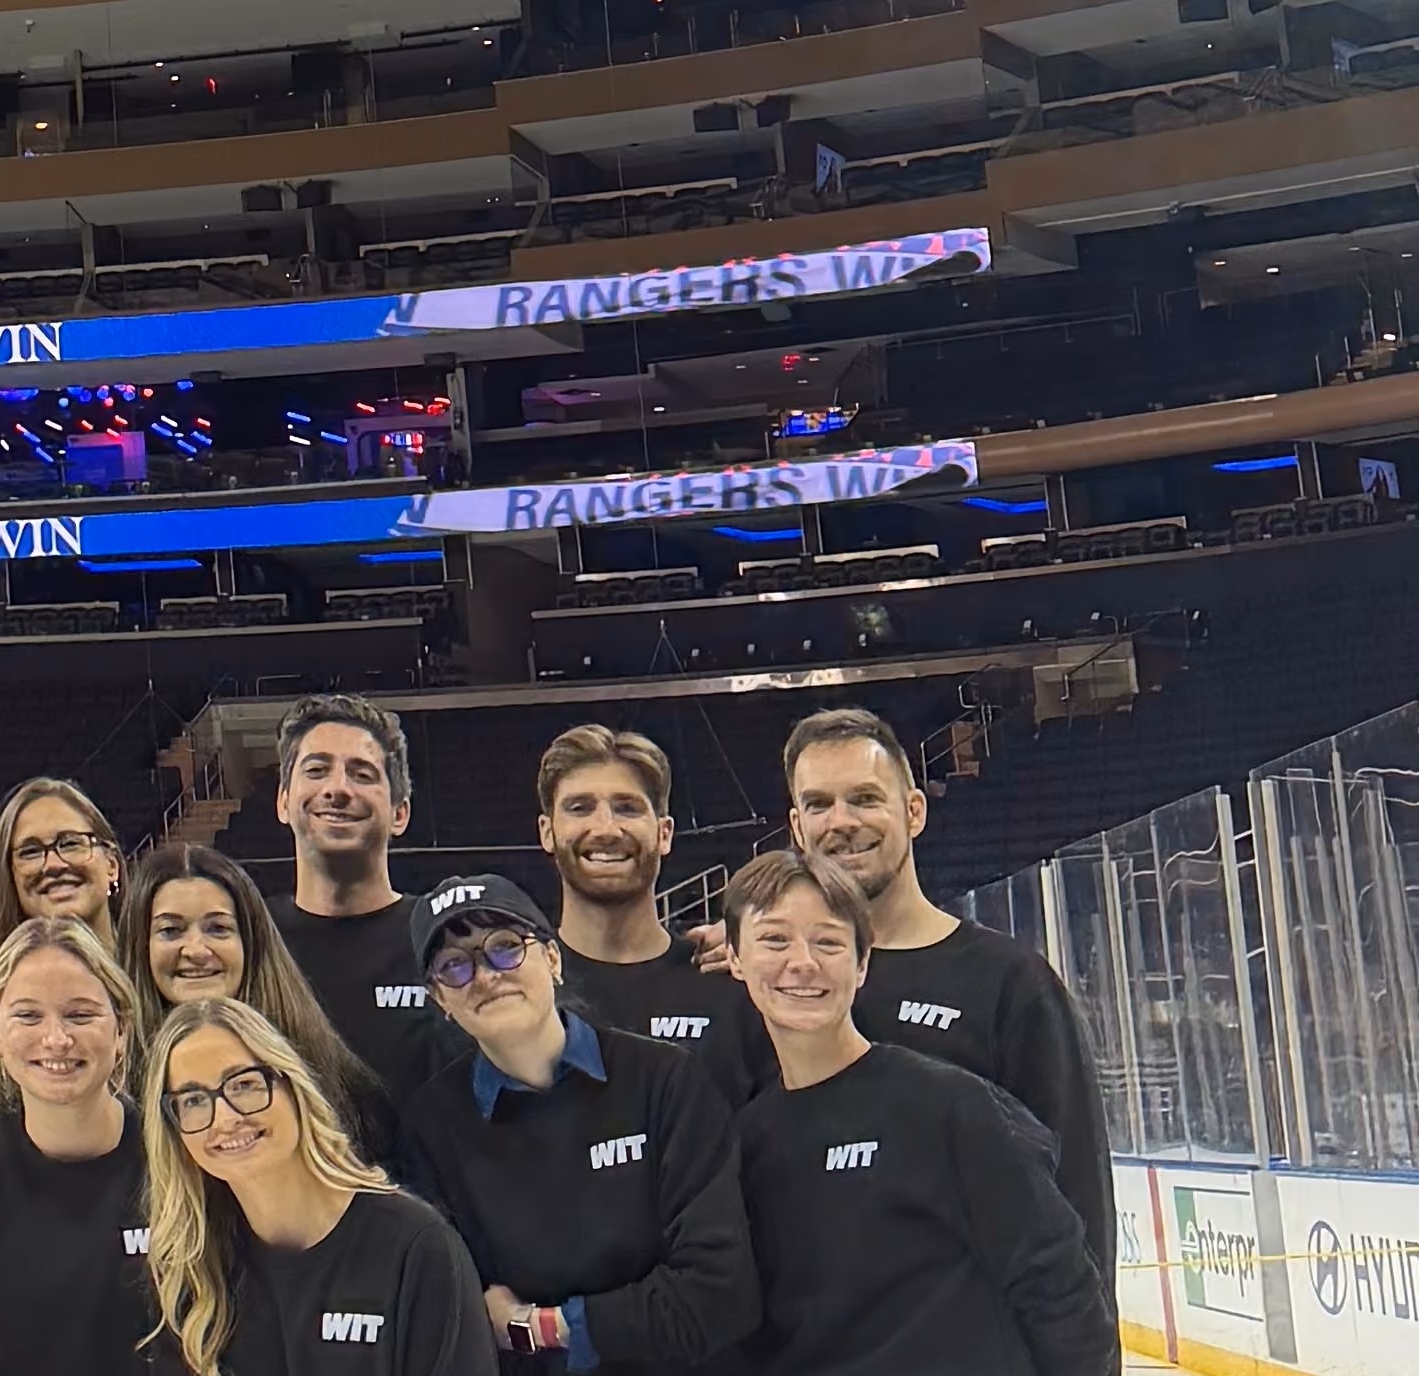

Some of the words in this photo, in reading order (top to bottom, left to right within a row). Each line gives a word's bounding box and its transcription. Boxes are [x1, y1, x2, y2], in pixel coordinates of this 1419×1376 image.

[496, 258, 809, 326] RANGERS
[506, 467, 805, 530] RANGERS
[431, 886, 486, 915] WIT
[376, 986, 426, 1007] WIT
[651, 1017, 710, 1038] WIT
[899, 1000, 961, 1030] WIT
[591, 1133, 647, 1170] WIT
[826, 1141, 878, 1171] WIT
[322, 1312, 385, 1343] WIT
